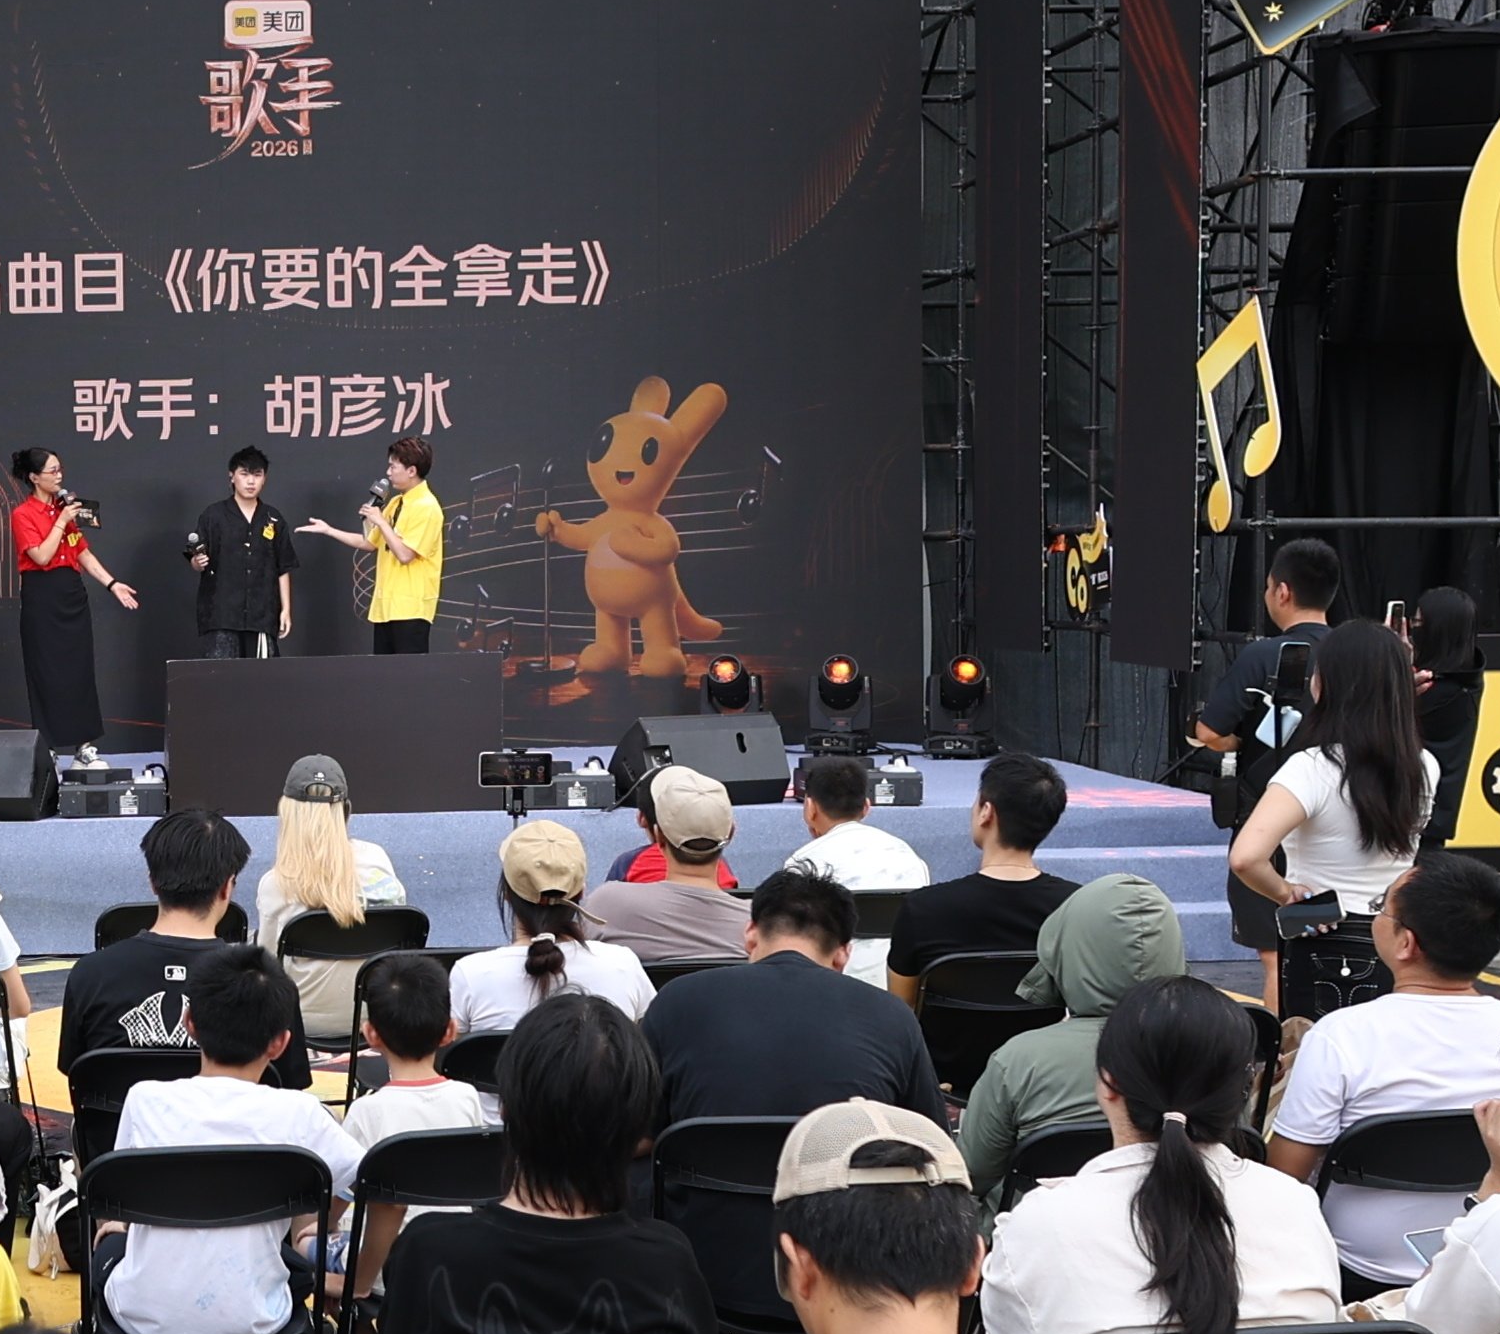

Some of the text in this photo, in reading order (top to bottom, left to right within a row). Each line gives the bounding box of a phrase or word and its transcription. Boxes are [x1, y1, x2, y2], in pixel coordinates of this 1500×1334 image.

[263, 10, 304, 32] 美团
[192, 50, 342, 157] 歌手
[251, 140, 299, 157] 2026
